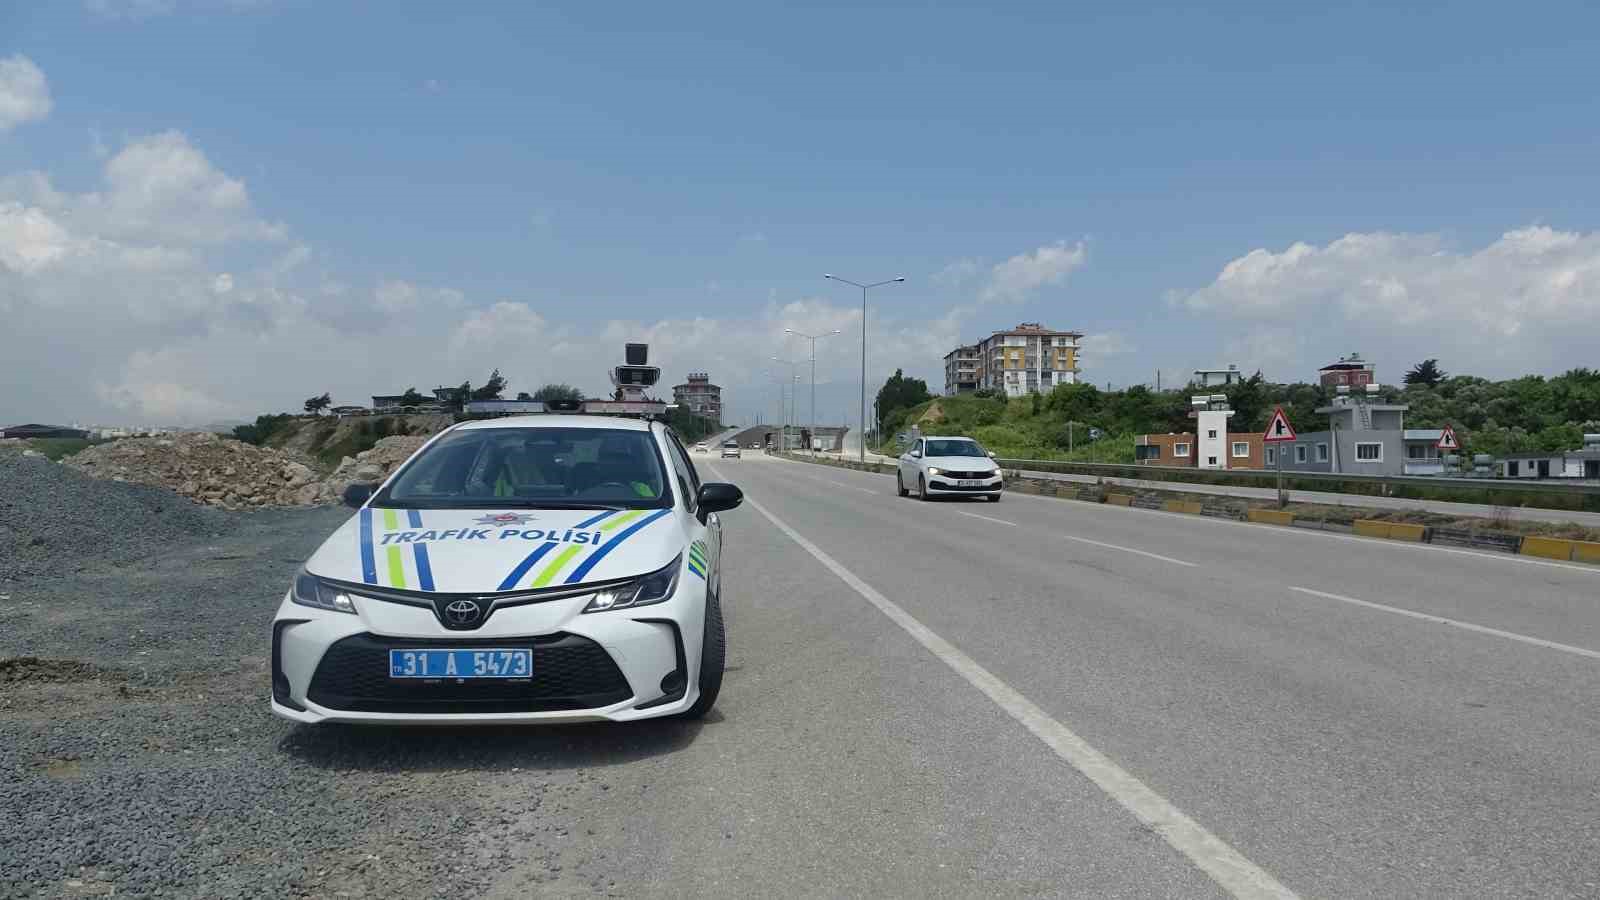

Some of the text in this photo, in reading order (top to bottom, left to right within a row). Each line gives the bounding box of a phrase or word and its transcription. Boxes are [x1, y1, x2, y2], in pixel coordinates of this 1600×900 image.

[499, 529, 601, 545] POLİSİ
[403, 652, 428, 675] 31
[446, 652, 458, 675] A
[473, 652, 527, 675] 5473
